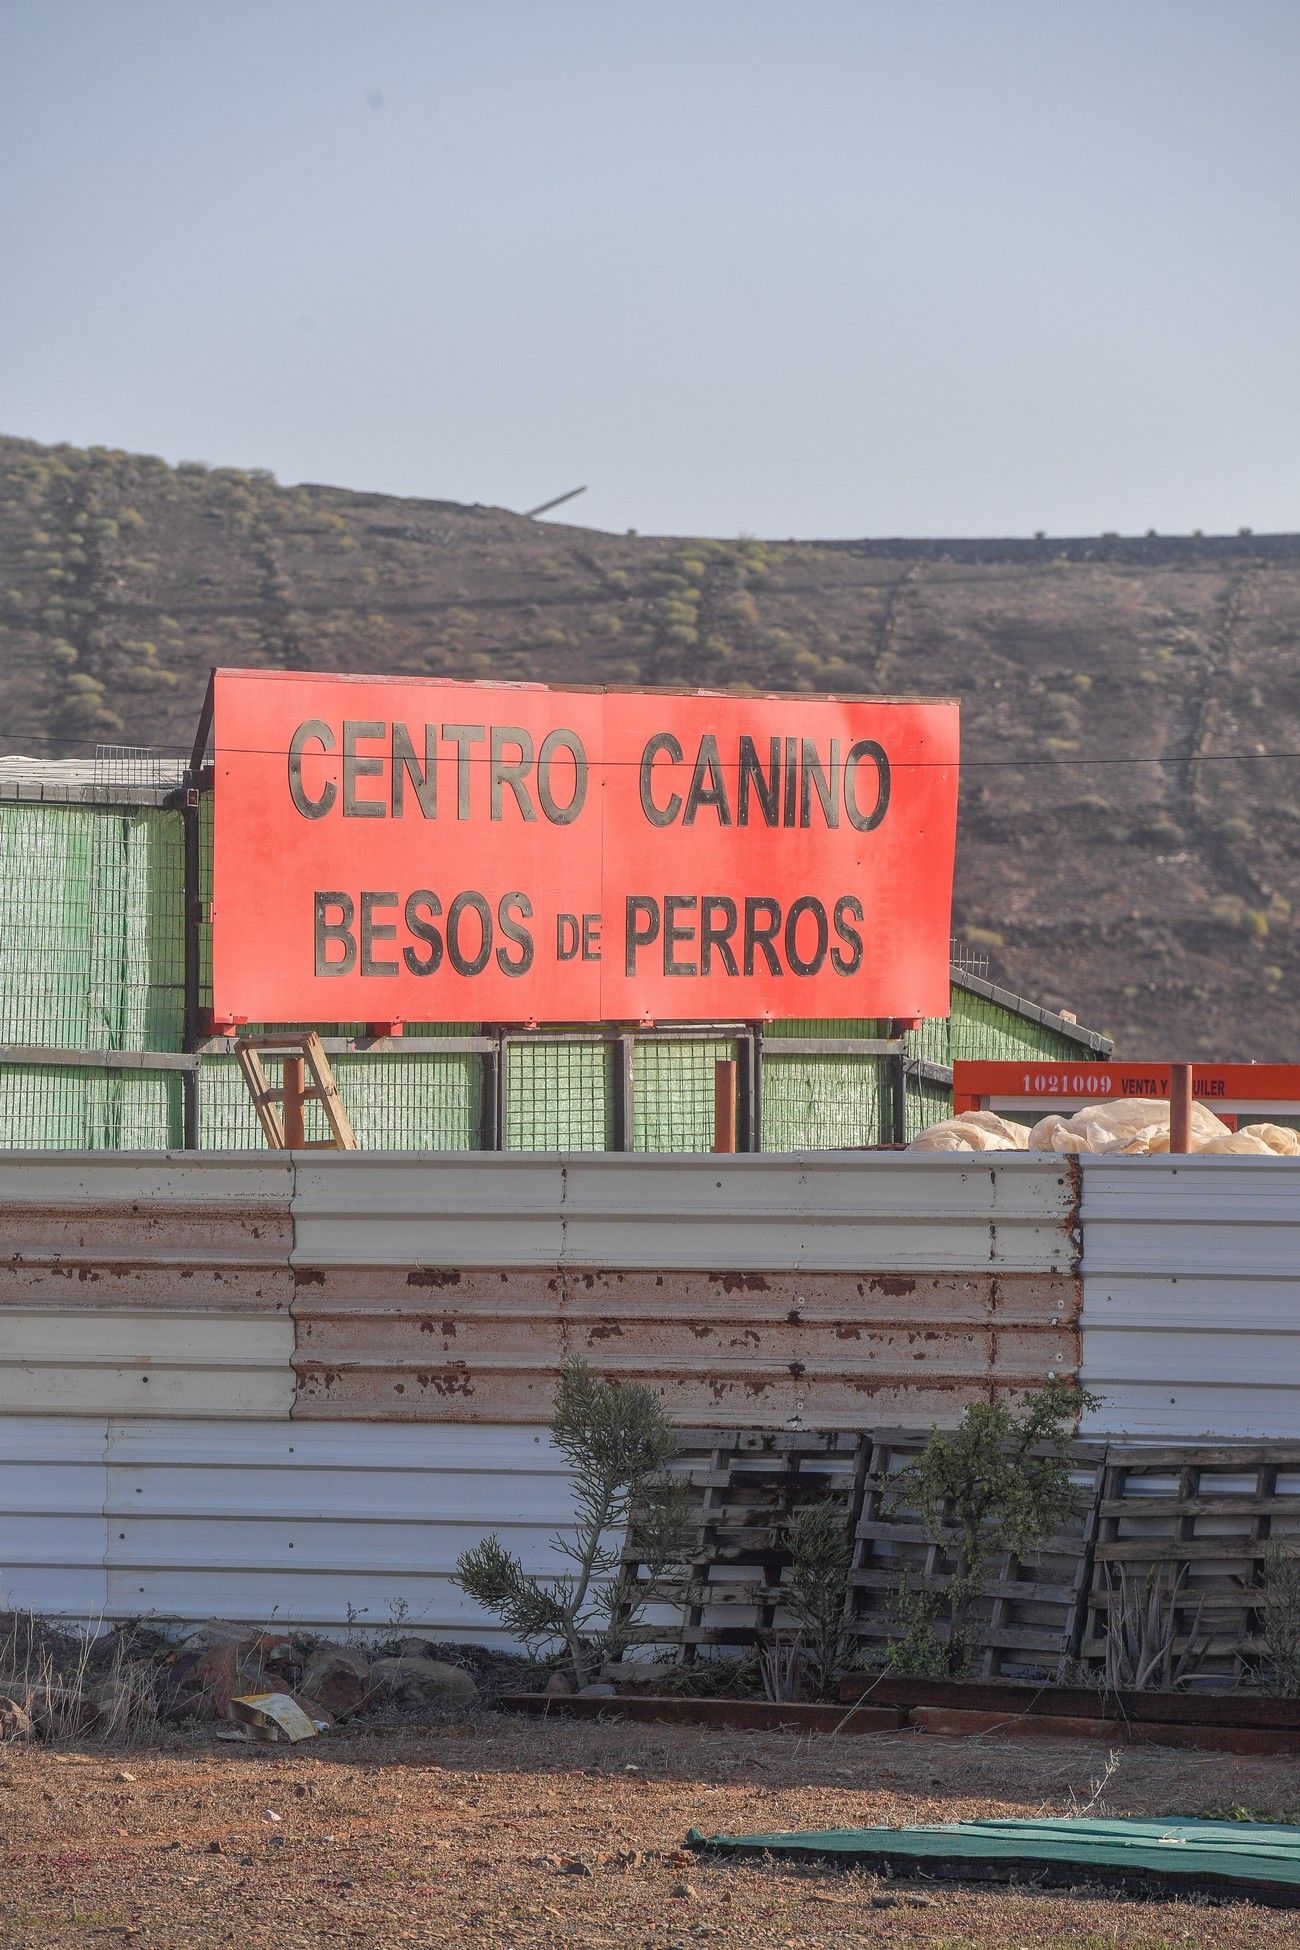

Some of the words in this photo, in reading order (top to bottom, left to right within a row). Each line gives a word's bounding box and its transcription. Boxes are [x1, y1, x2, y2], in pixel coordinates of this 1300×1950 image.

[288, 719, 589, 826] CENTRO
[640, 732, 891, 833] CANINO
[314, 890, 535, 978] BESOS
[556, 913, 602, 962] DE
[625, 896, 864, 978] PERROS
[1023, 1074, 1112, 1093] 1021009
[1121, 1079, 1157, 1096] VENTA
[1160, 1080, 1168, 1095] Y
[1192, 1080, 1225, 1096] UILER
